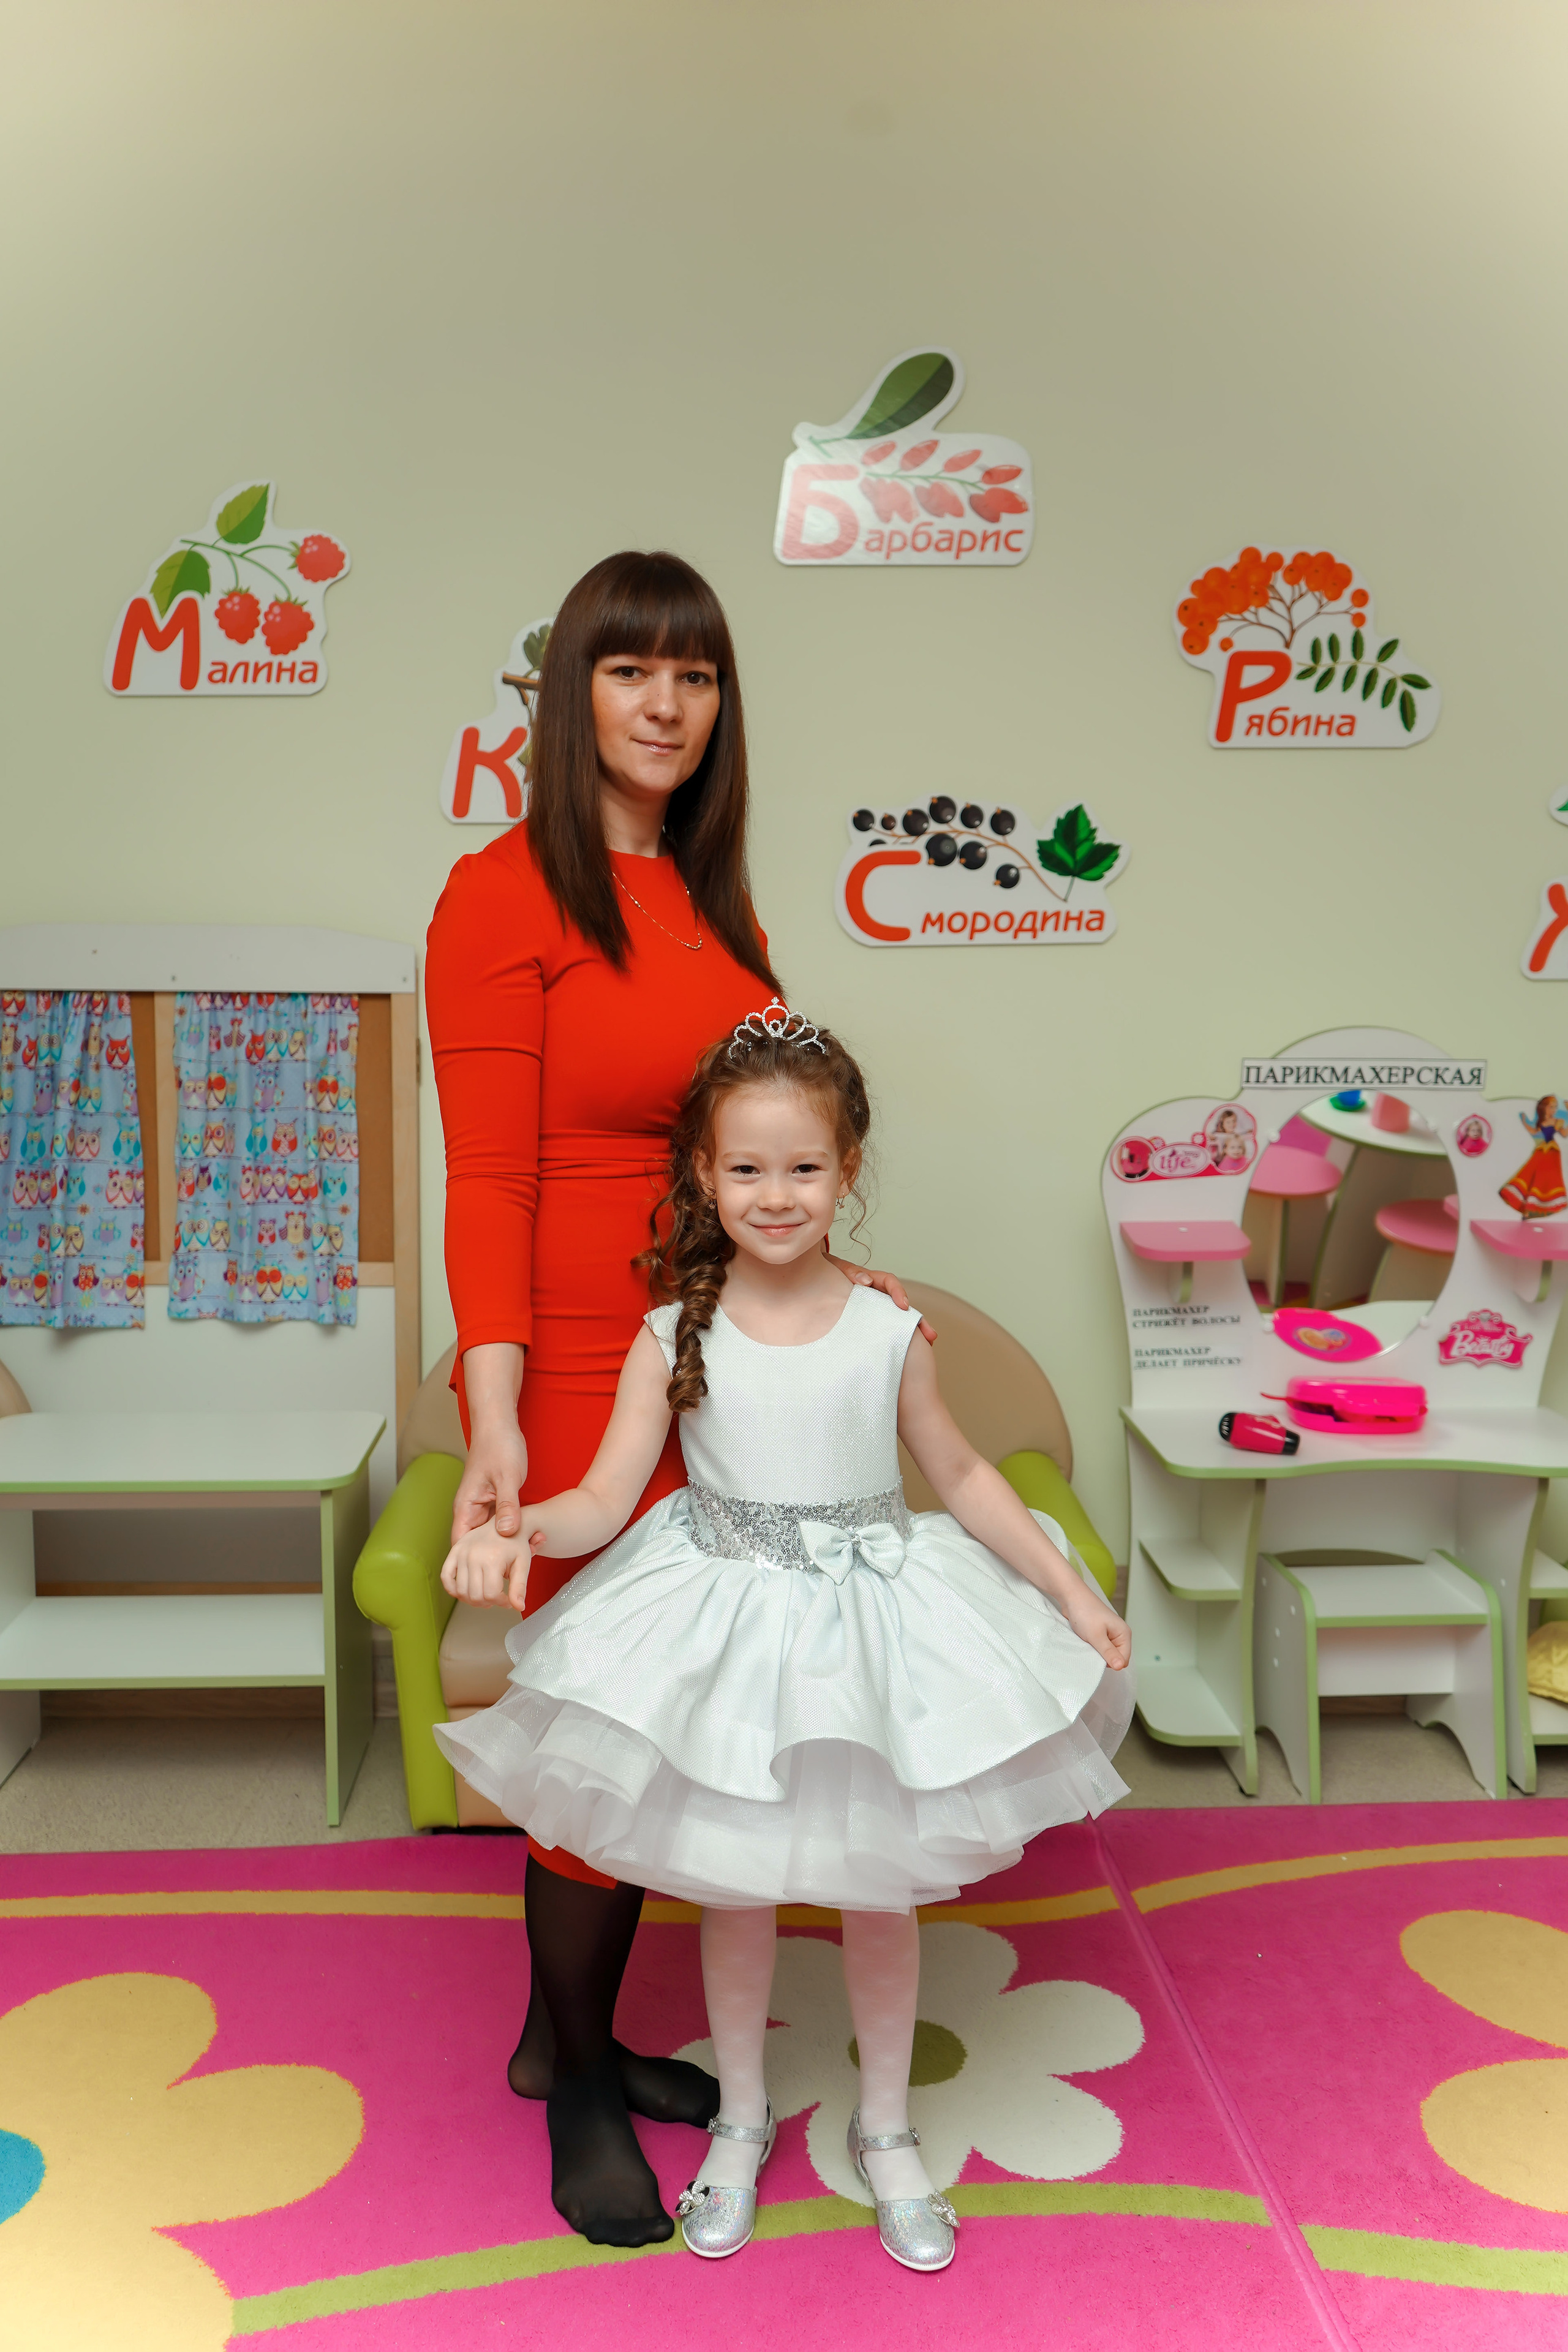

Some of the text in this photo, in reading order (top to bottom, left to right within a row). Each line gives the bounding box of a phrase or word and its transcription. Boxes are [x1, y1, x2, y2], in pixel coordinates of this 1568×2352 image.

[782, 464, 1025, 560] Барбарис
[111, 597, 318, 690] Малина
[1216, 650, 1357, 742] Рябина
[845, 850, 1105, 941] Смородина
[1245, 1065, 1482, 1085] ПАРИКМАХЕРСКАЯ
[1133, 1305, 1210, 1316] ПАРИКМАХЕР
[1192, 1316, 1241, 1326] ВОЛОСЫ
[1134, 1347, 1210, 1356] ПАРИКМАХЕР
[1450, 1330, 1515, 1359] Beauty
[1134, 1359, 1177, 1369] ДЕЛАЕТ
